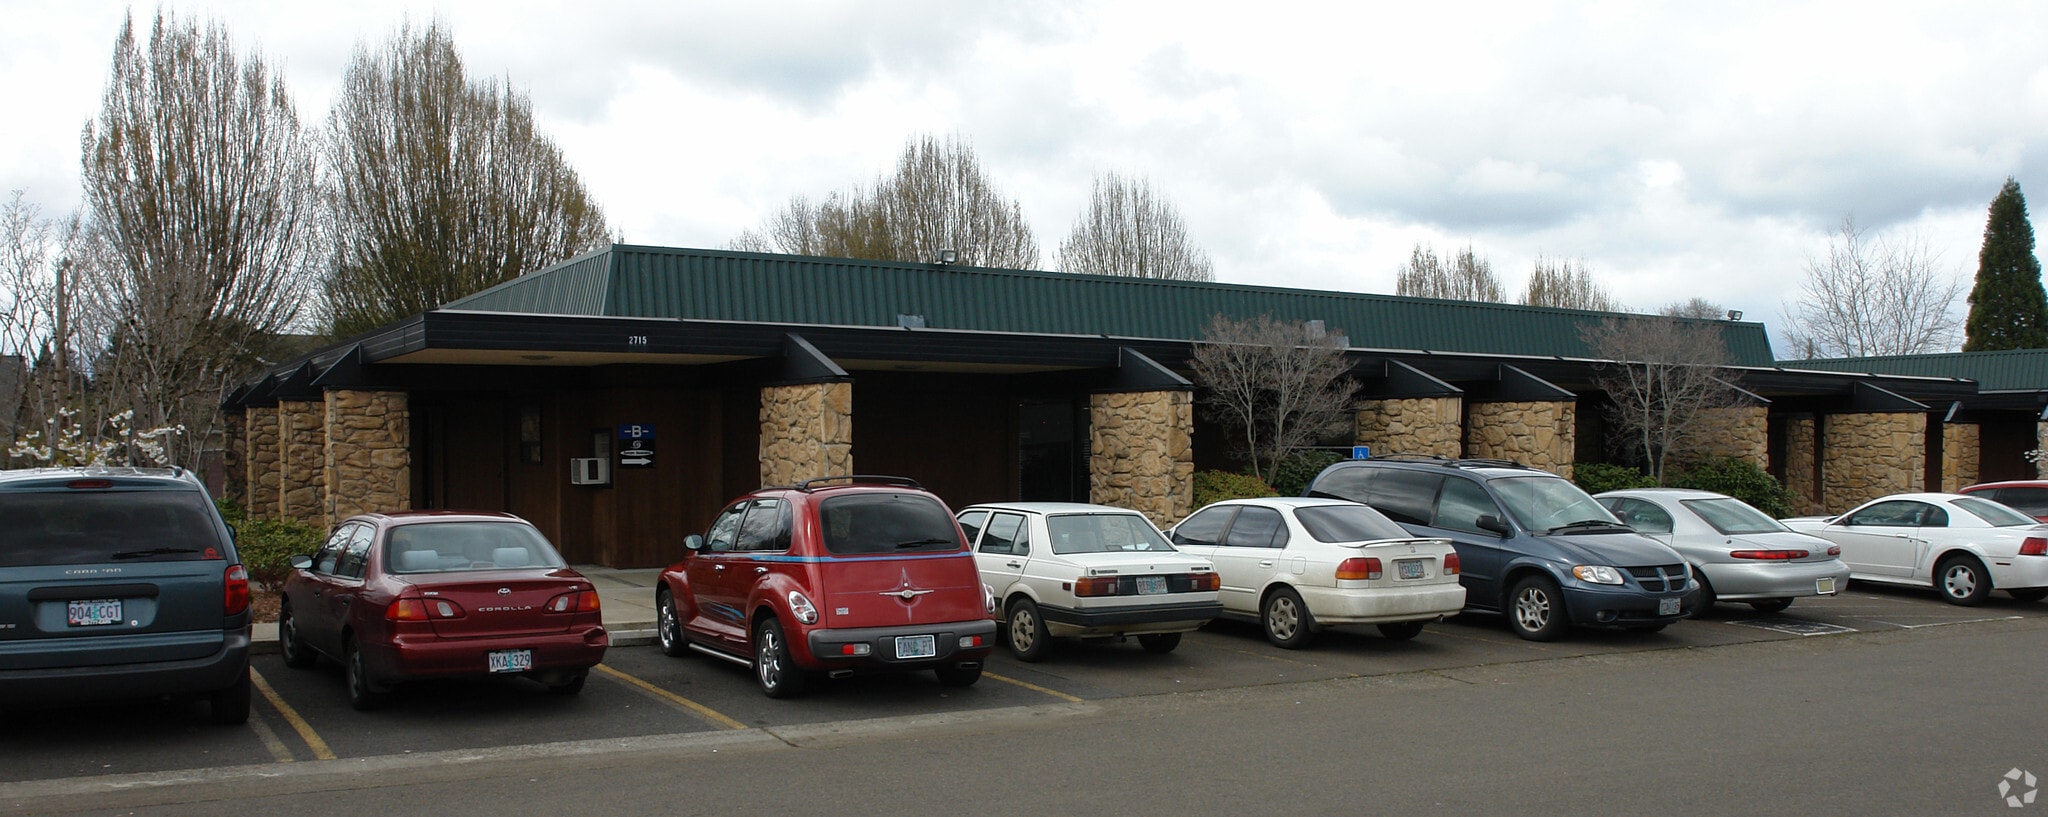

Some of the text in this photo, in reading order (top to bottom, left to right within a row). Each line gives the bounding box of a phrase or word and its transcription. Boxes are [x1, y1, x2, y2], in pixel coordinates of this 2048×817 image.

[629, 336, 647, 345] 2715
[70, 604, 120, 620] 904 CGT
[490, 655, 508, 669] XKA
[513, 654, 530, 667] 329
